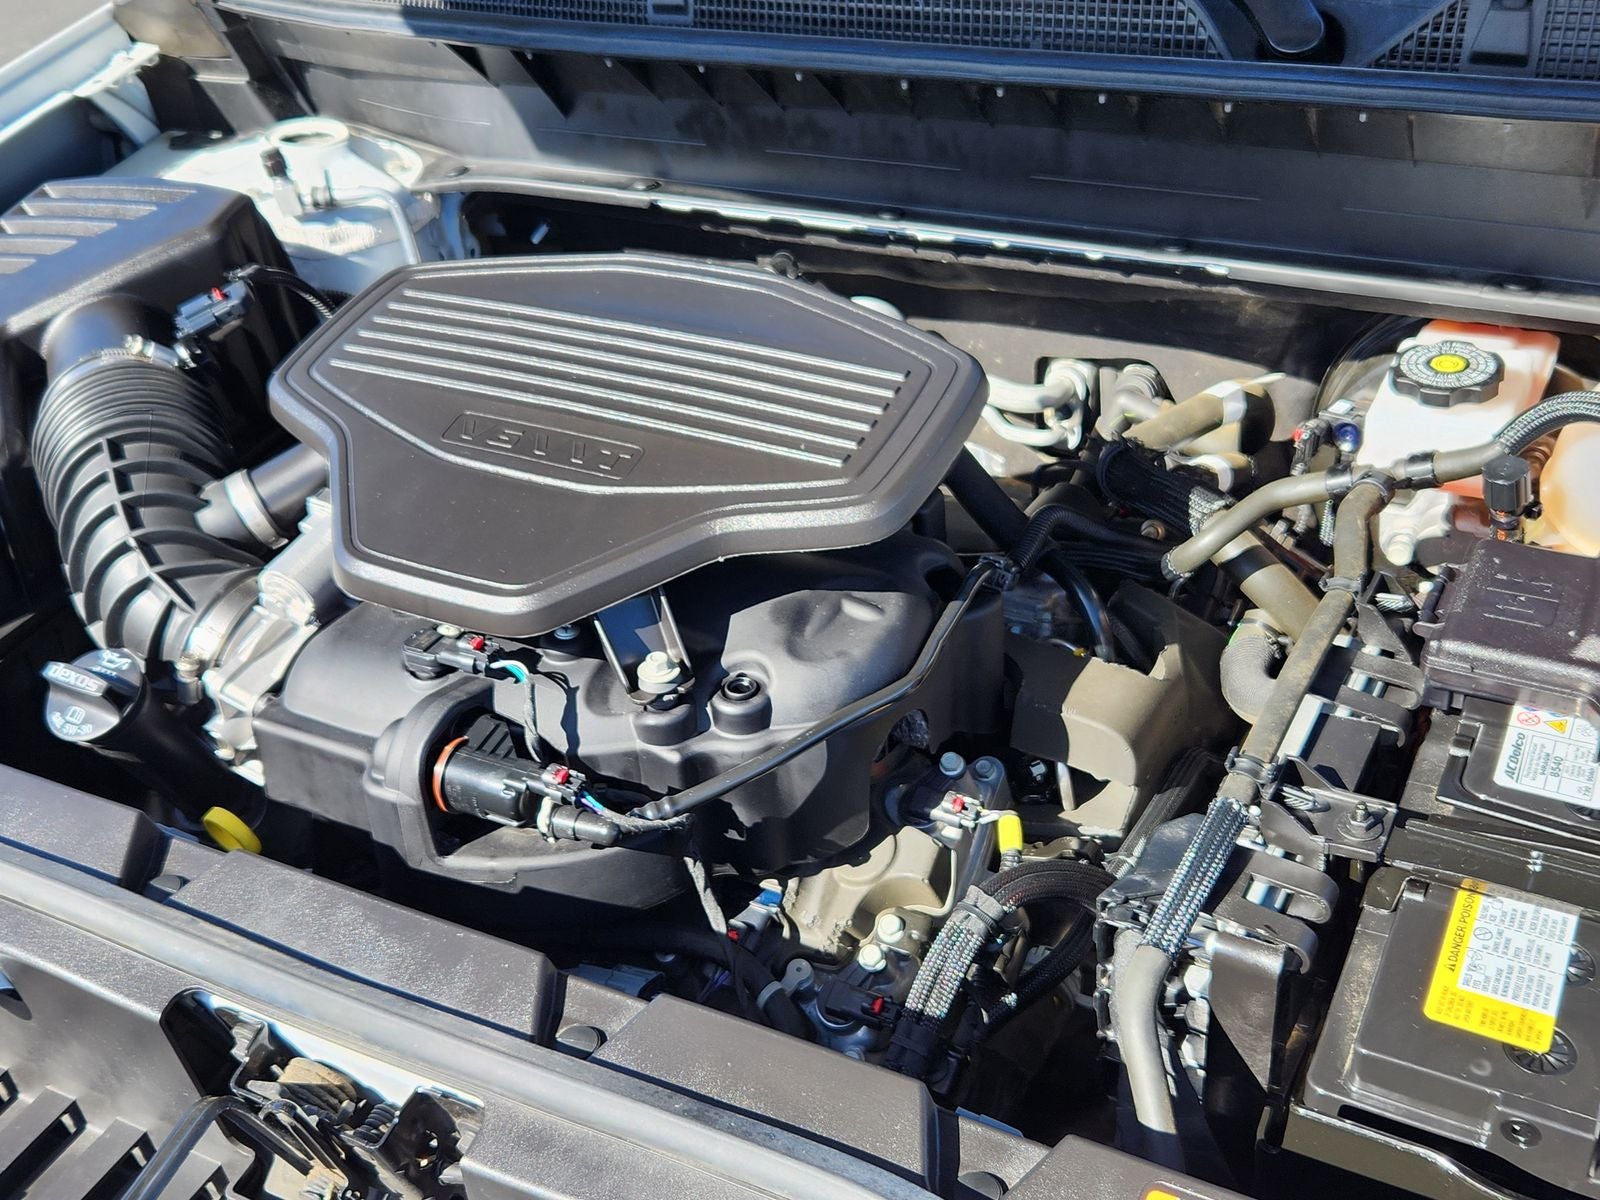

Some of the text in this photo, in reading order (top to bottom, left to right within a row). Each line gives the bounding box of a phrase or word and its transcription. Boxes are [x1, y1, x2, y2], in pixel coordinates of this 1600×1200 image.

[49, 663, 102, 691] dexos
[1504, 732, 1526, 780] ACDelco
[1550, 755, 1564, 778] 8540
